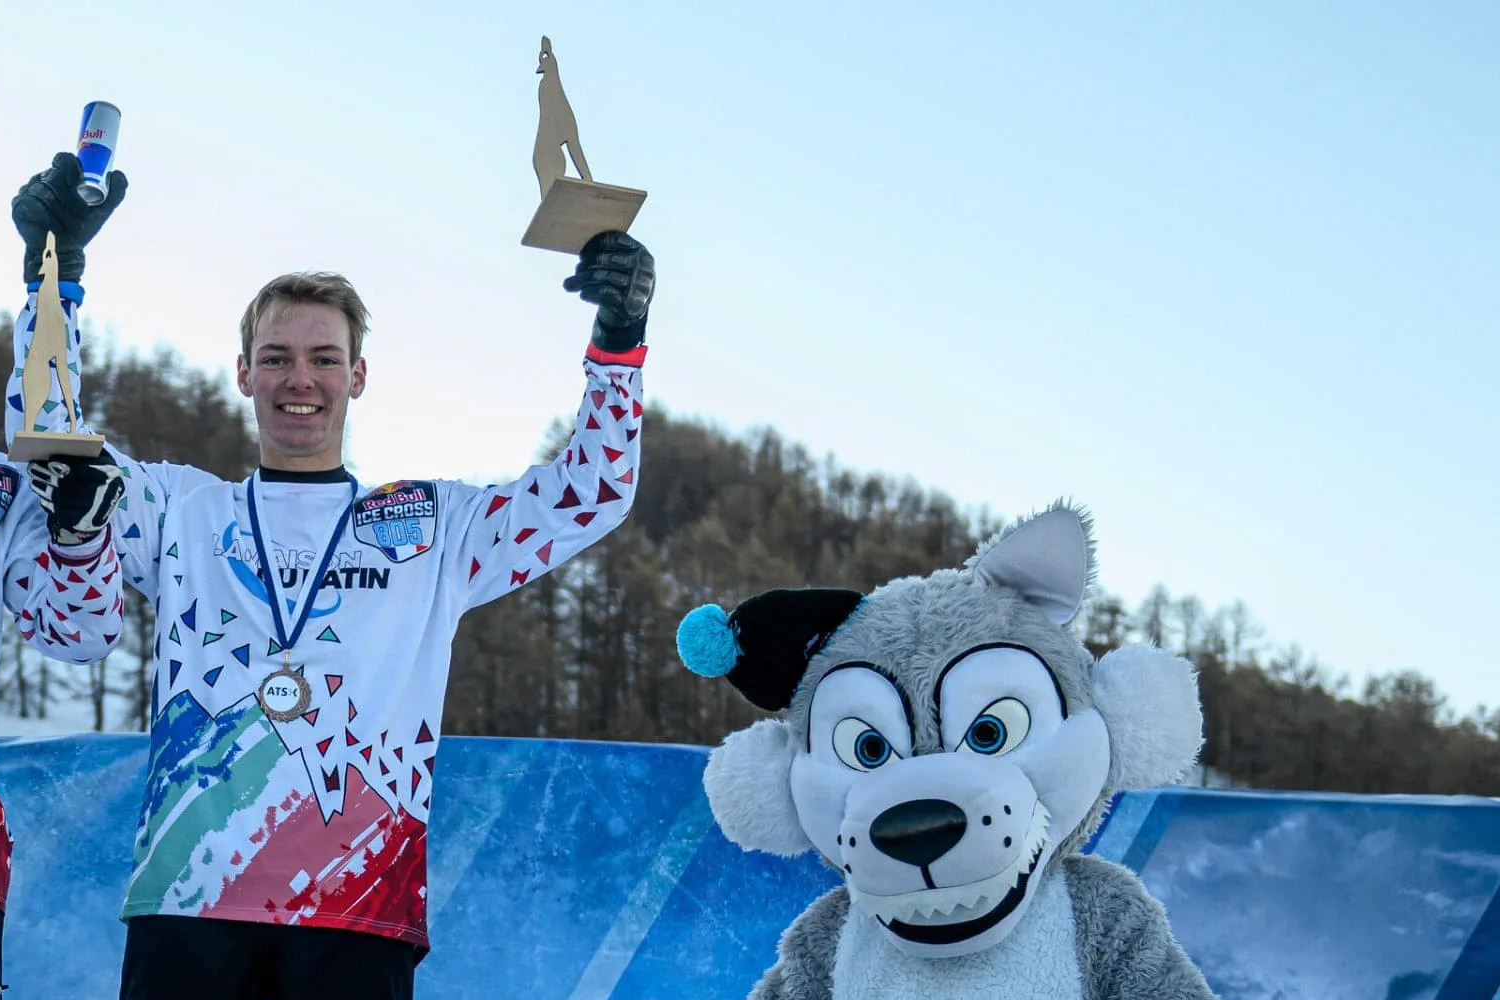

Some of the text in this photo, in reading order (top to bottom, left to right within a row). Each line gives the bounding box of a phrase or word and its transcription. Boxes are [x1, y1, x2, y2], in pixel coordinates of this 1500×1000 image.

[362, 488, 427, 511] Red Bull
[357, 500, 434, 526] ICE CROSS
[371, 518, 424, 547] 805
